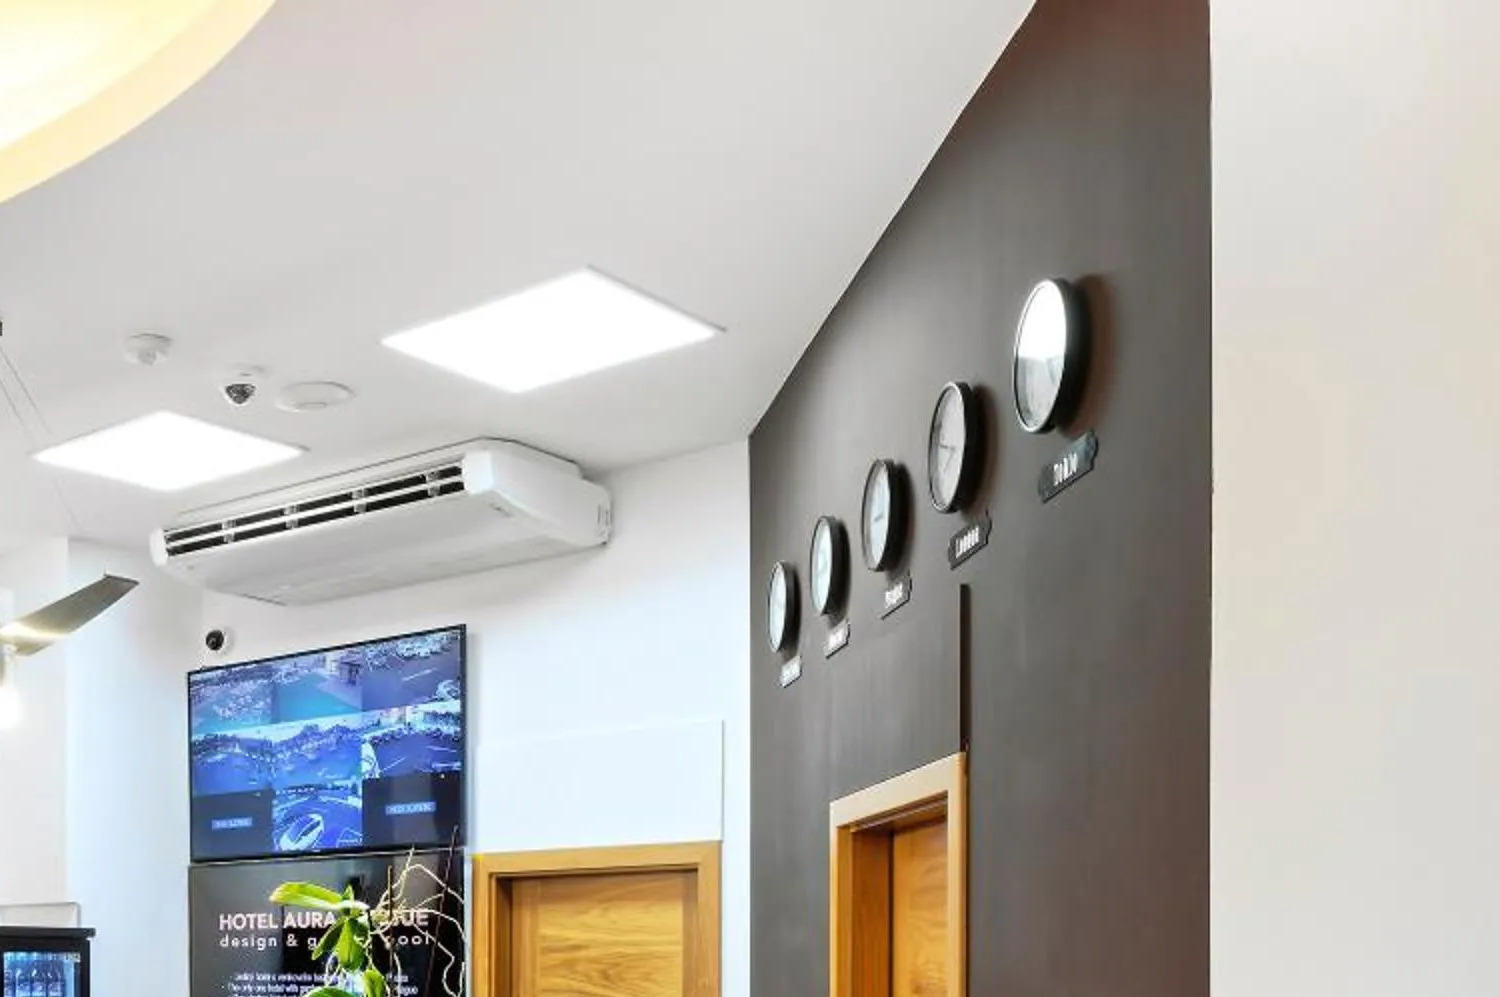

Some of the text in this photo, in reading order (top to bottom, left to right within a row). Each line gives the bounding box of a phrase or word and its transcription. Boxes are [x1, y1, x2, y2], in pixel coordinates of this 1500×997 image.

[219, 913, 279, 931] HOTEL
[283, 911, 337, 929] AURA
[219, 934, 277, 950] design
[286, 934, 299, 947] &
